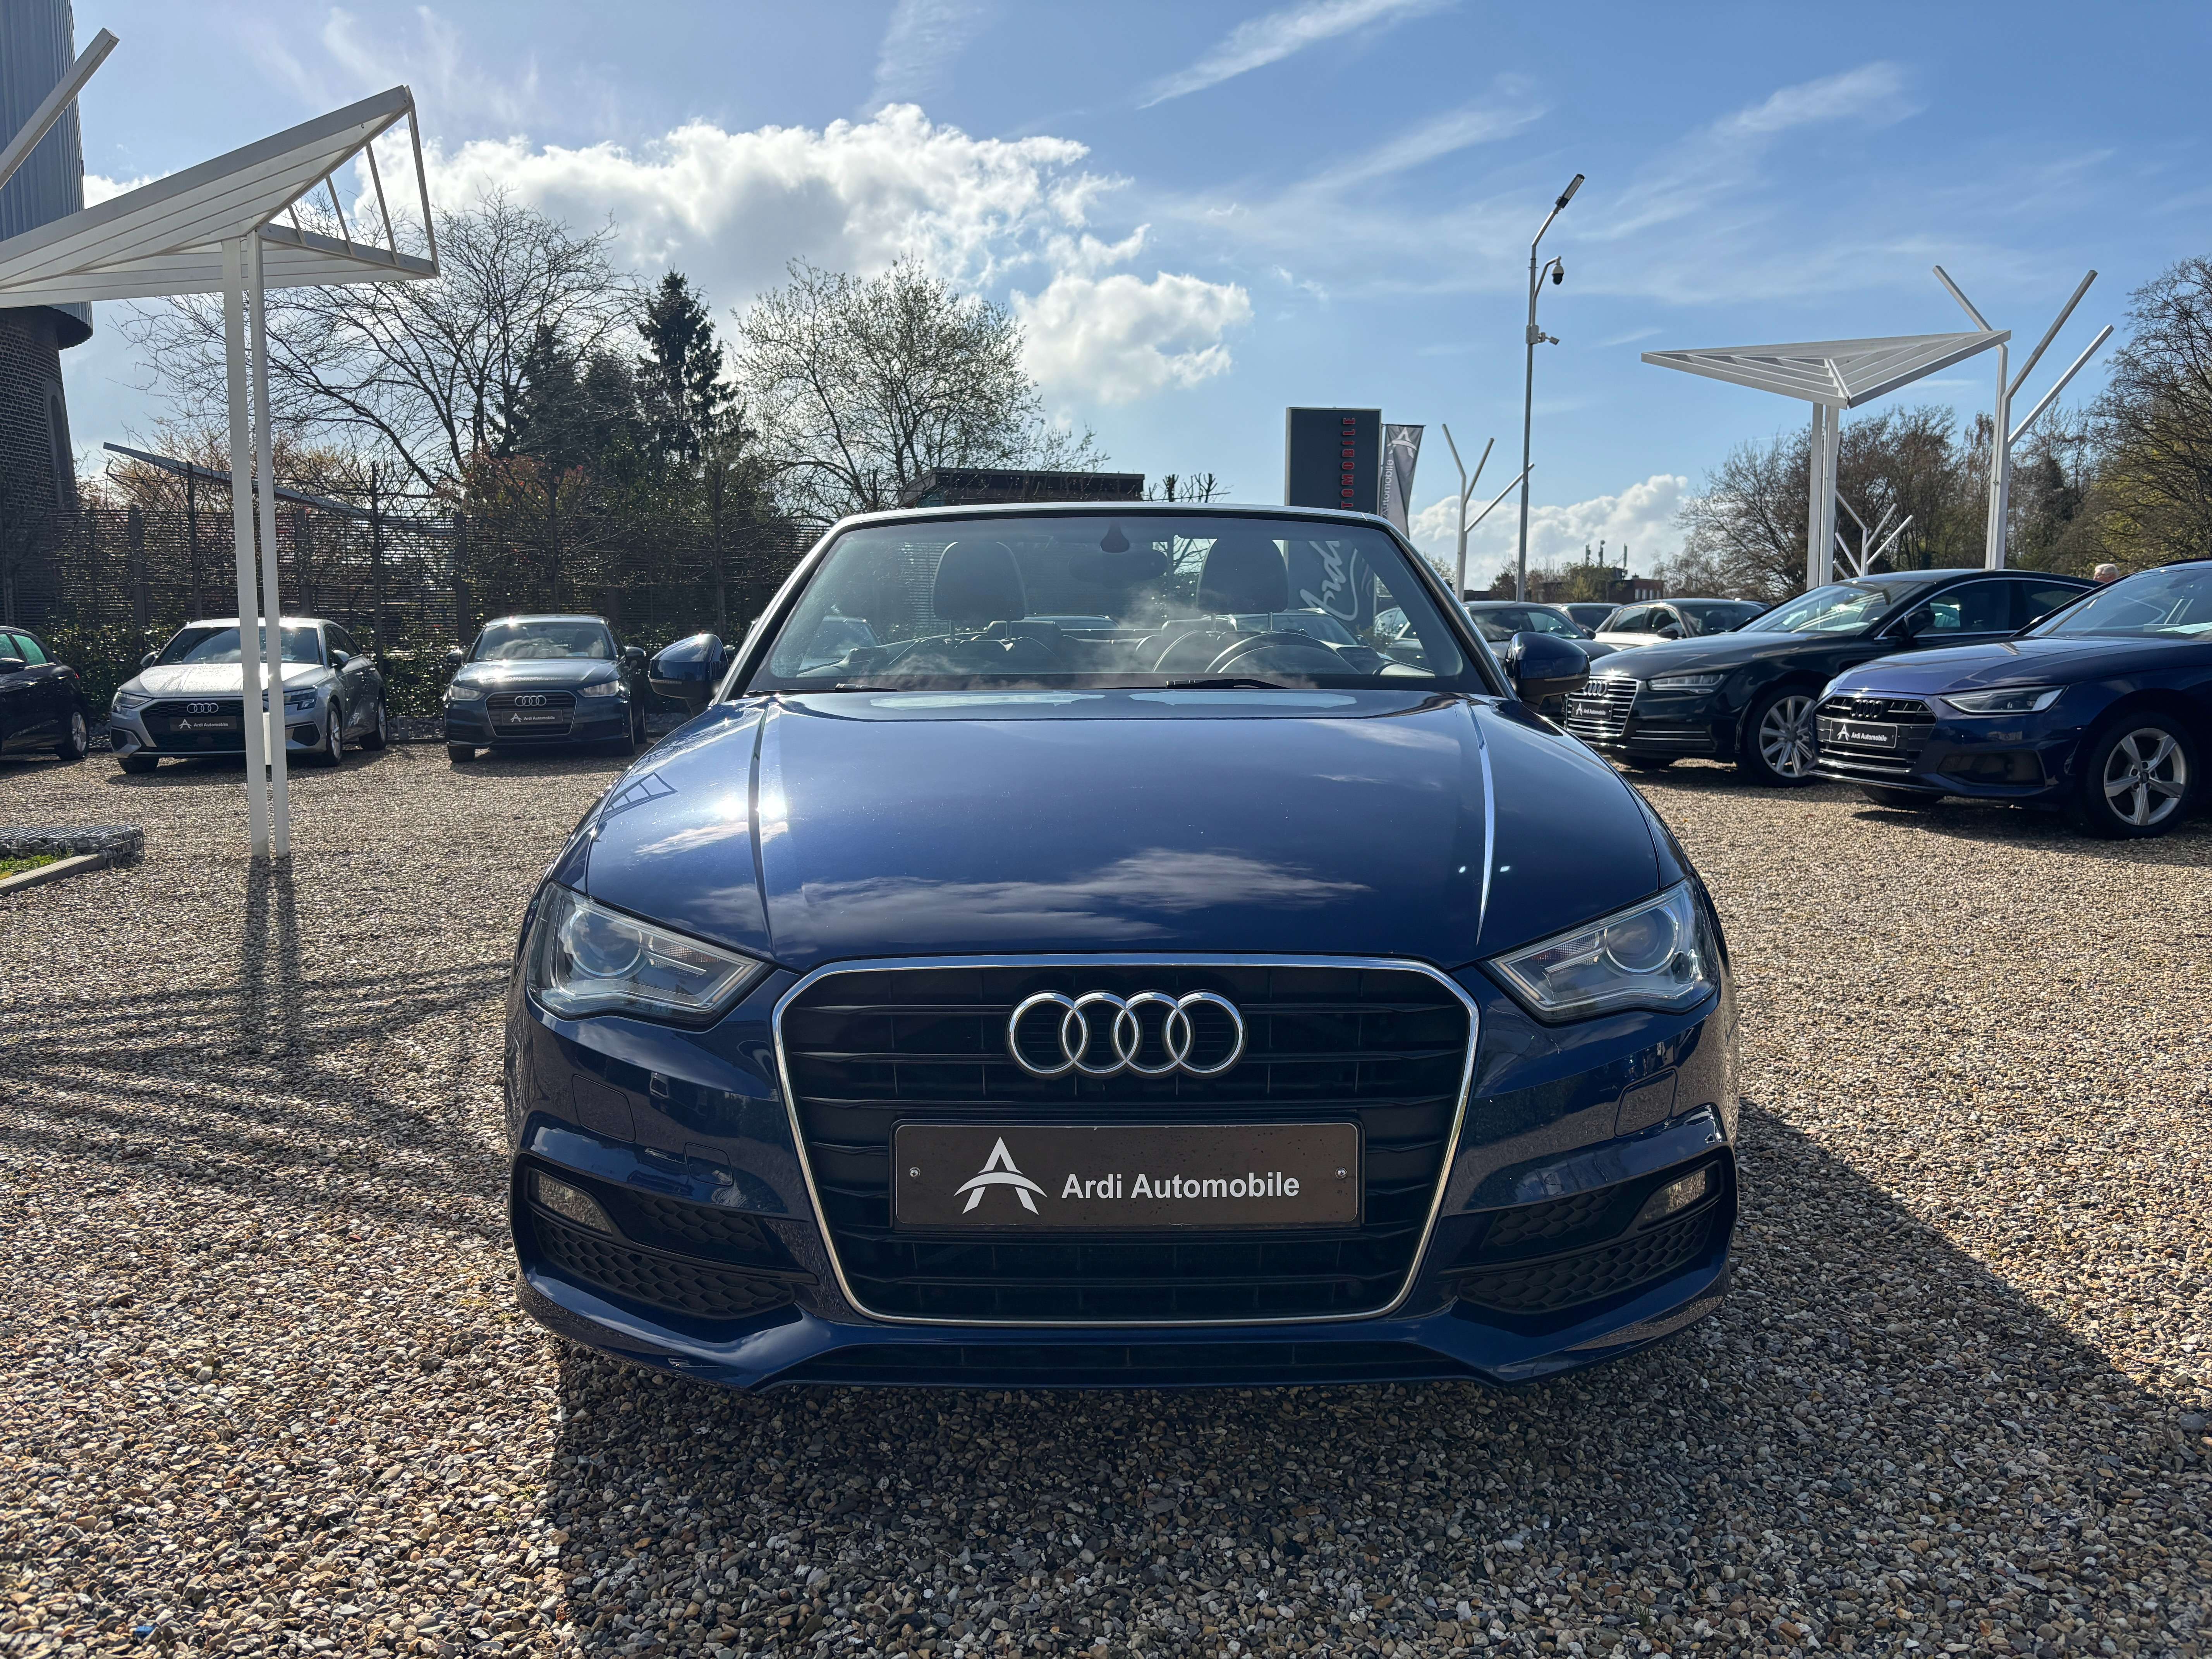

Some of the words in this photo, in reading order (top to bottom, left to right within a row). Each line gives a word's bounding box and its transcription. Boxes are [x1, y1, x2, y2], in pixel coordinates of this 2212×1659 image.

[1341, 417, 1355, 509] TOMOBILE
[1300, 541, 1358, 621] Ard
[1860, 733, 1887, 742] Automobile
[1061, 1173, 1122, 1199] Ardi
[1130, 1171, 1300, 1199] Automobile
